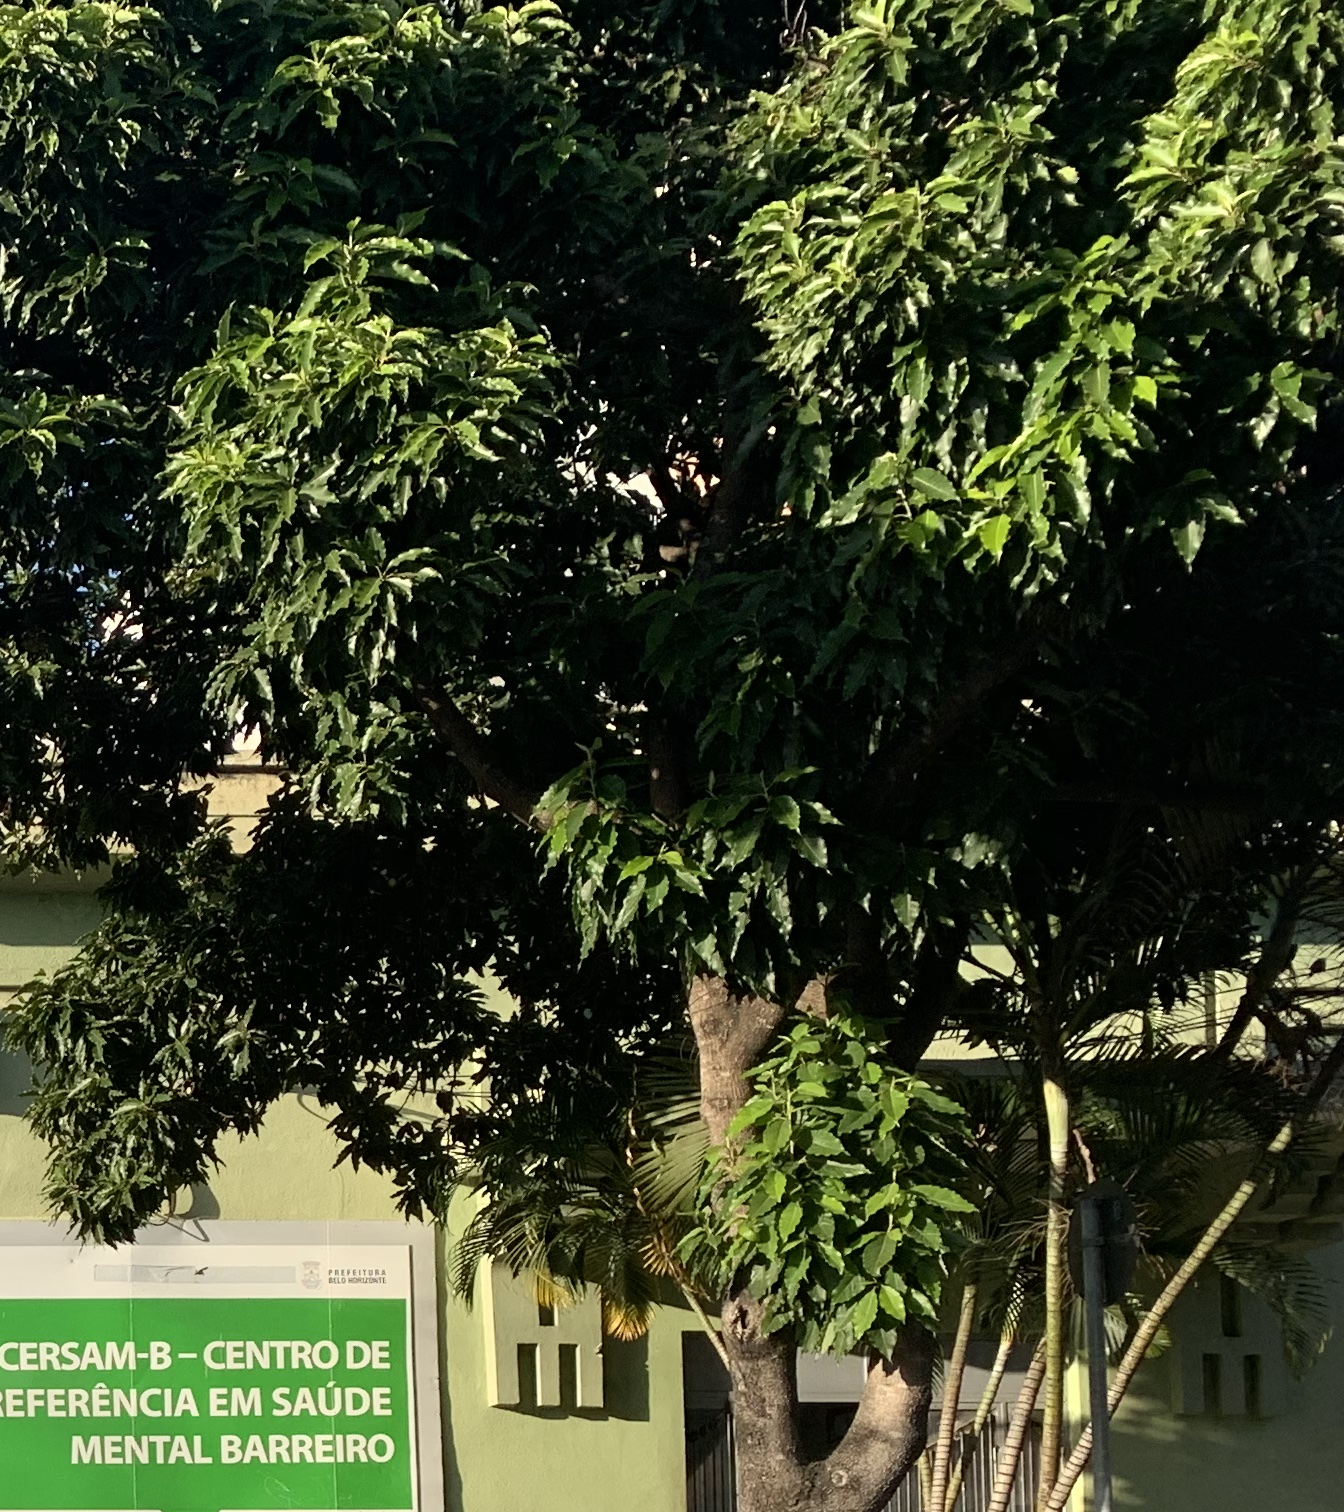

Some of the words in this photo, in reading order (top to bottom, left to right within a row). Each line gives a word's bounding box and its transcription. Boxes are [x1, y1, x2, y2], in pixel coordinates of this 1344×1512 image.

[202, 1339, 339, 1371] CENTRO
[345, 1340, 390, 1370] DE
[209, 1387, 263, 1417] EM
[272, 1381, 393, 1417] SAÚDE
[70, 1434, 212, 1465] MENTAL
[220, 1434, 395, 1464] BARREIRO
